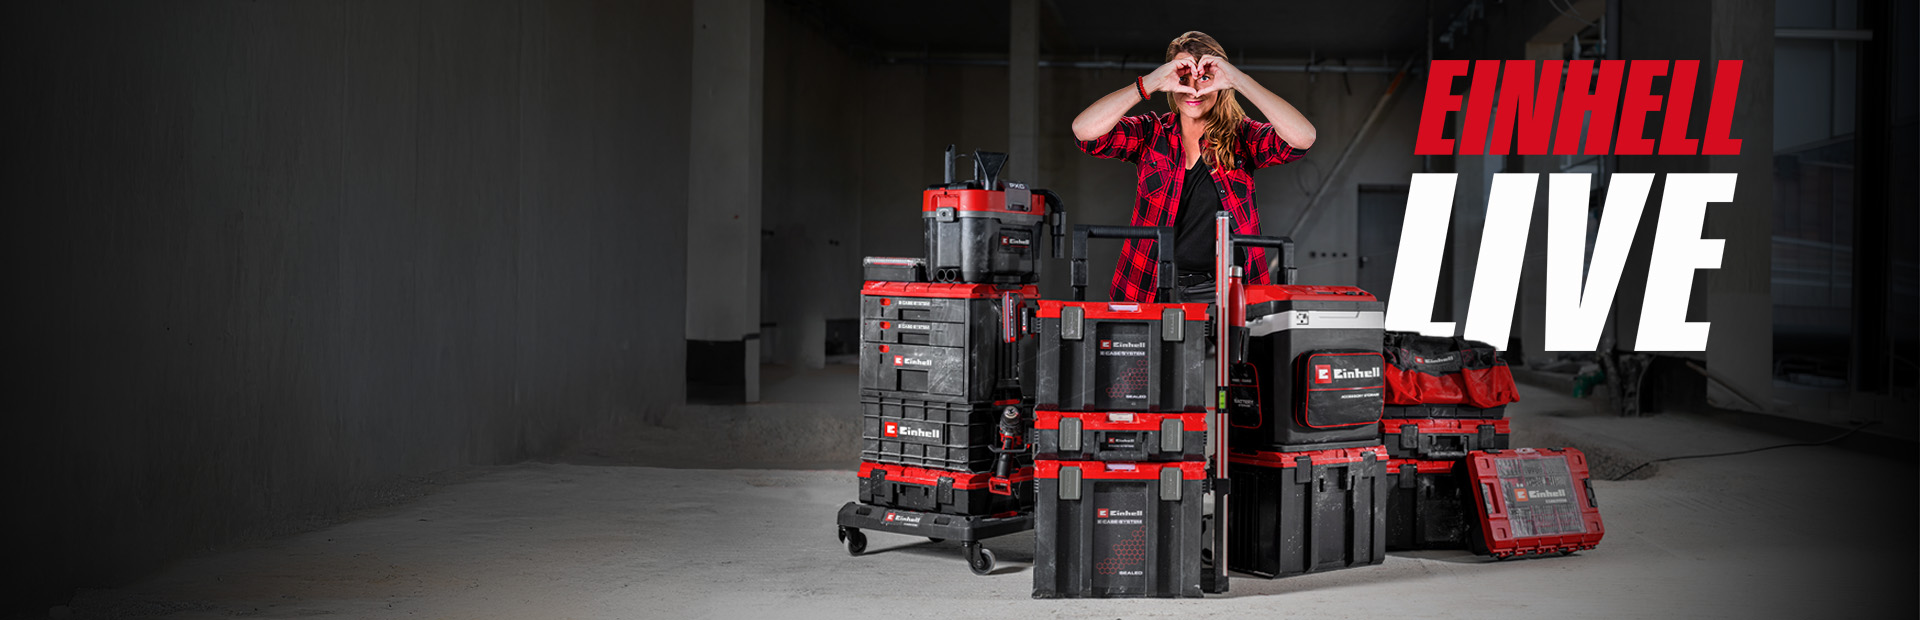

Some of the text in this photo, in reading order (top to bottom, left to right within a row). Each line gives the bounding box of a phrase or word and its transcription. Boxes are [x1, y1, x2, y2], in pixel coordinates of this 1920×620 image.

[904, 357, 932, 366] Einhell
[1333, 367, 1380, 380] Einhell
[899, 427, 940, 439] Einhell
[1528, 489, 1566, 498] Einhell
[895, 515, 921, 523] Einhell
